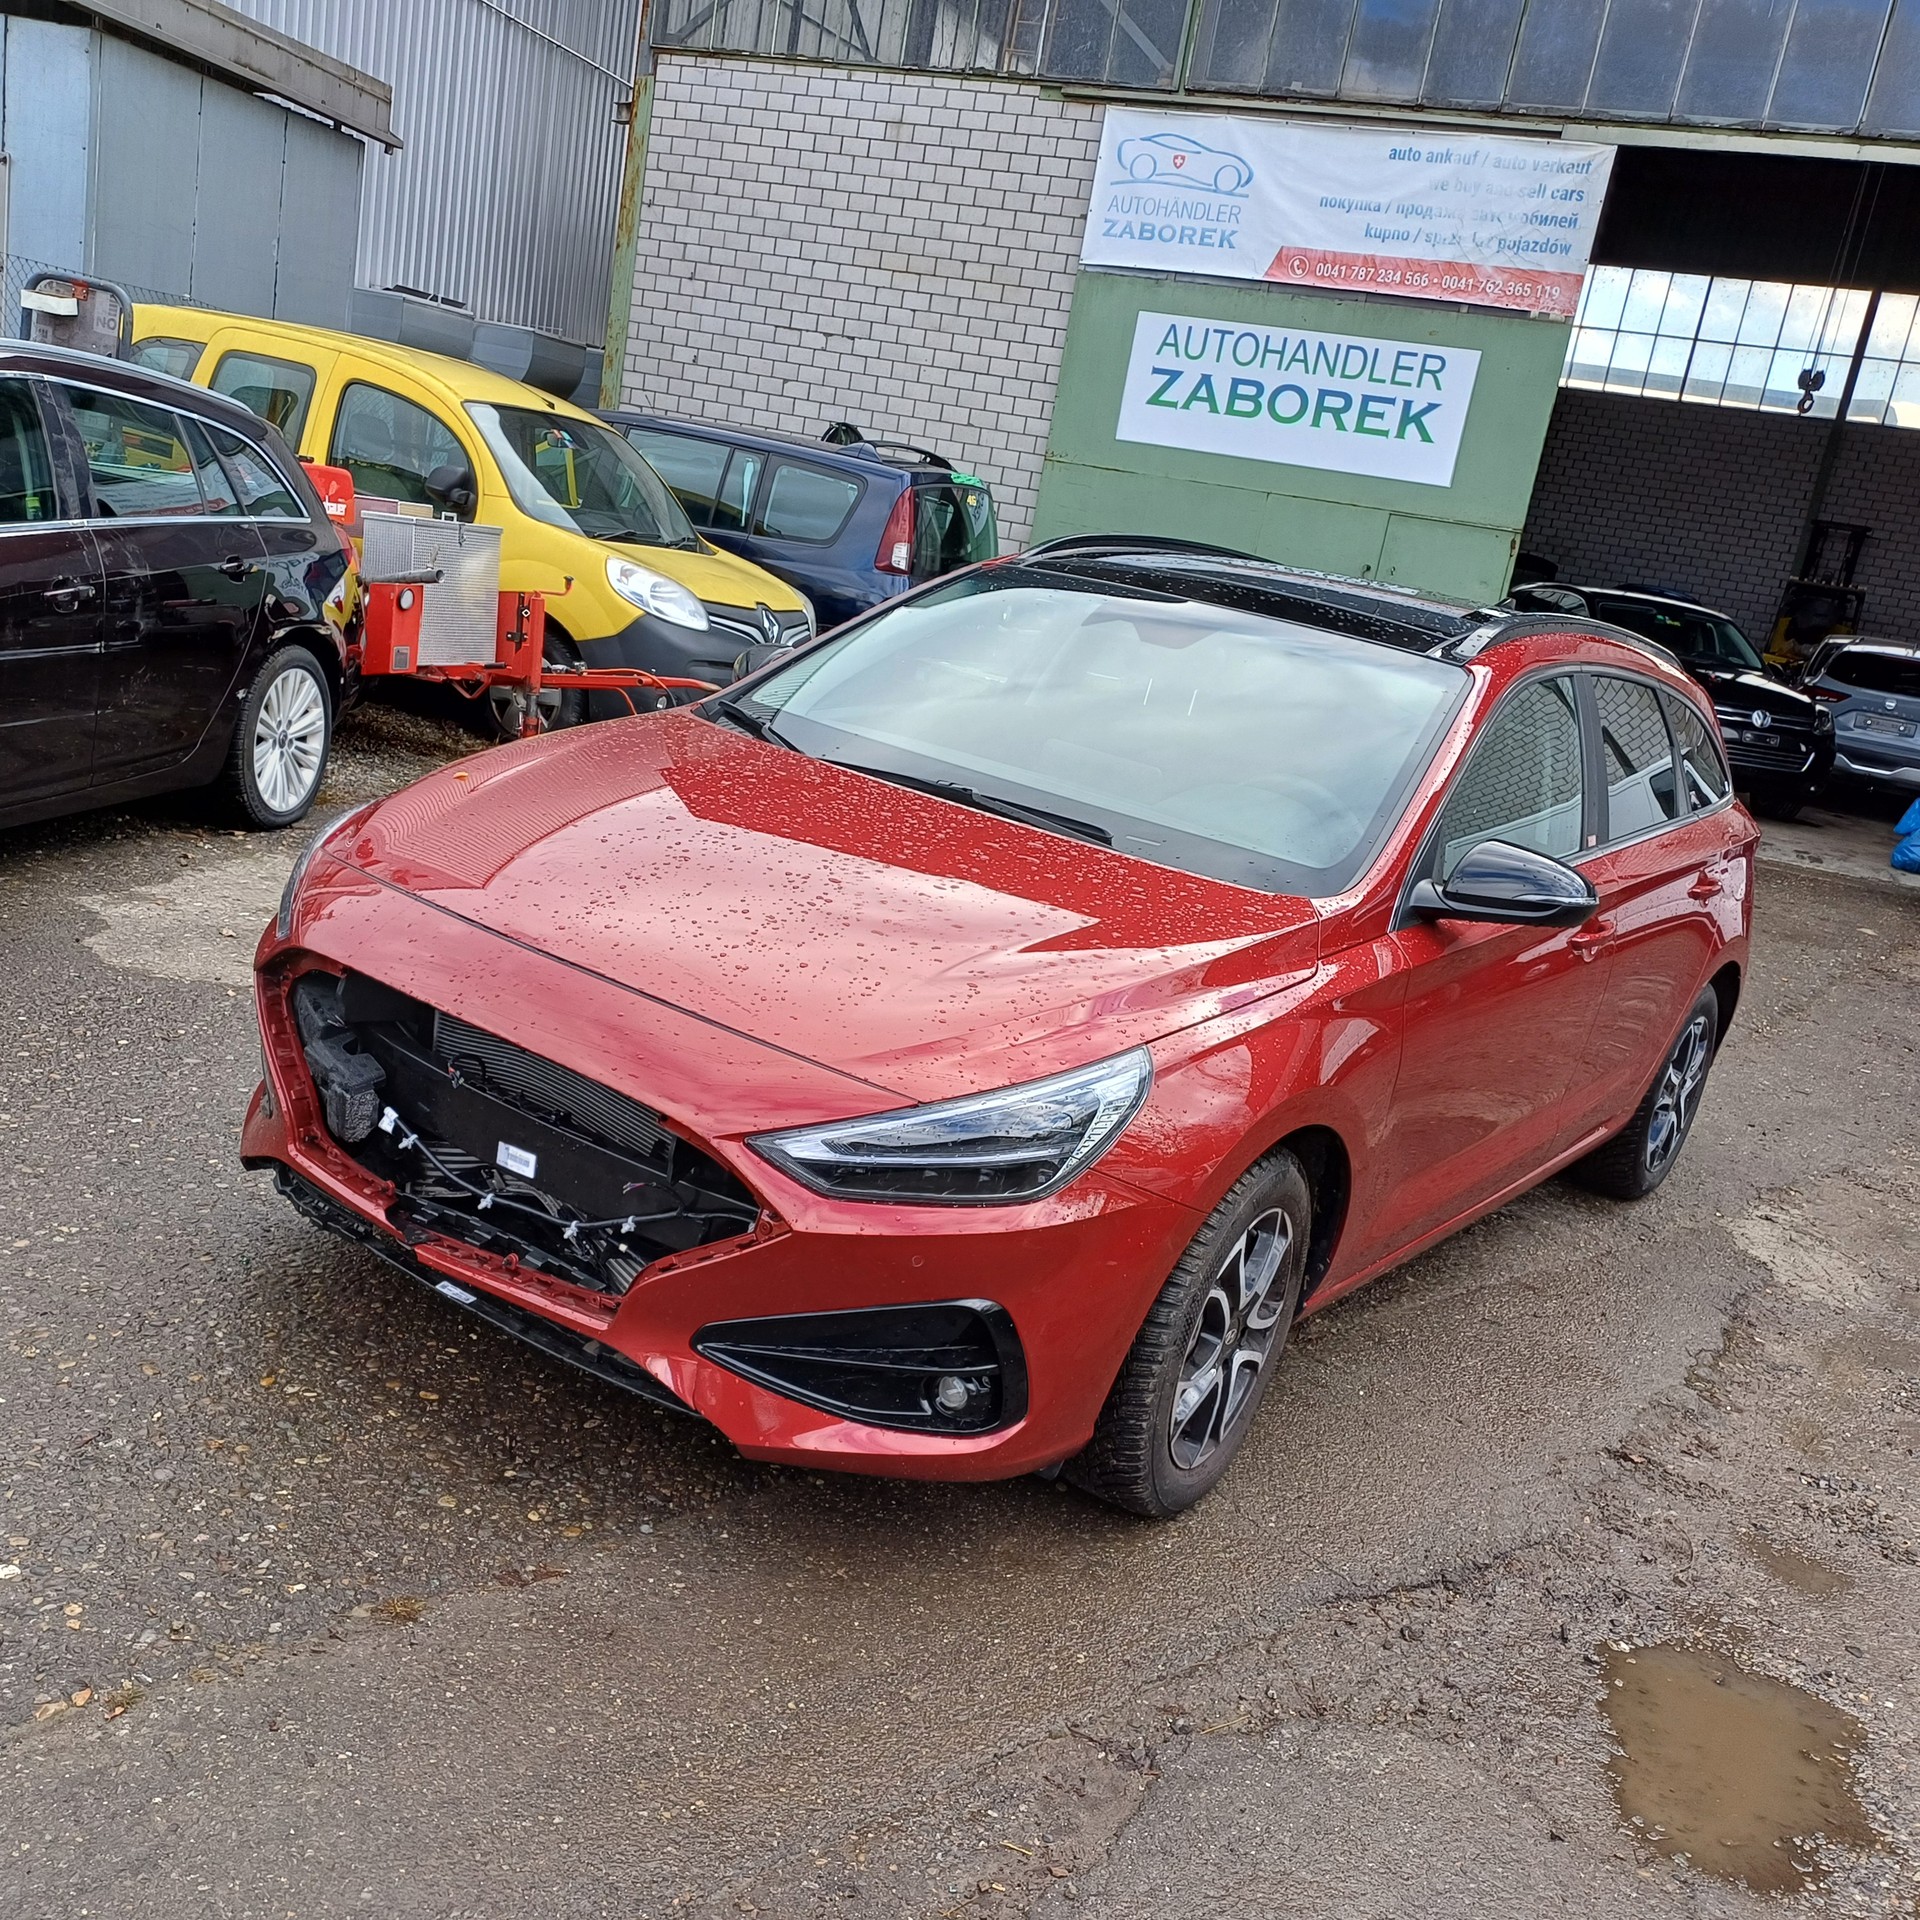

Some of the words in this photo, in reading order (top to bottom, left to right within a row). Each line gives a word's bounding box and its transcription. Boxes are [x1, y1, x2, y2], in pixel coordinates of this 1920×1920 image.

[1388, 147, 1422, 163] auto
[1425, 149, 1480, 167] ankauf
[1492, 157, 1527, 172] auto
[1319, 195, 1382, 214] покупка
[1519, 183, 1547, 200] sell
[1550, 188, 1586, 202] cars
[1107, 194, 1242, 225] AUTOHÄNDLER
[1102, 217, 1239, 249] ZABOREK
[1364, 222, 1410, 244] kupno
[1315, 262, 1347, 279] 0041
[1350, 266, 1376, 283] 787
[1376, 269, 1402, 285] 234
[1404, 271, 1430, 287] 566
[1441, 274, 1474, 292] 0041
[1477, 278, 1507, 295] 762
[1505, 282, 1532, 297] 365
[1535, 283, 1562, 300] 119
[1155, 322, 1448, 392] AUTOHANDLER
[1144, 365, 1443, 445] ZABOREK
